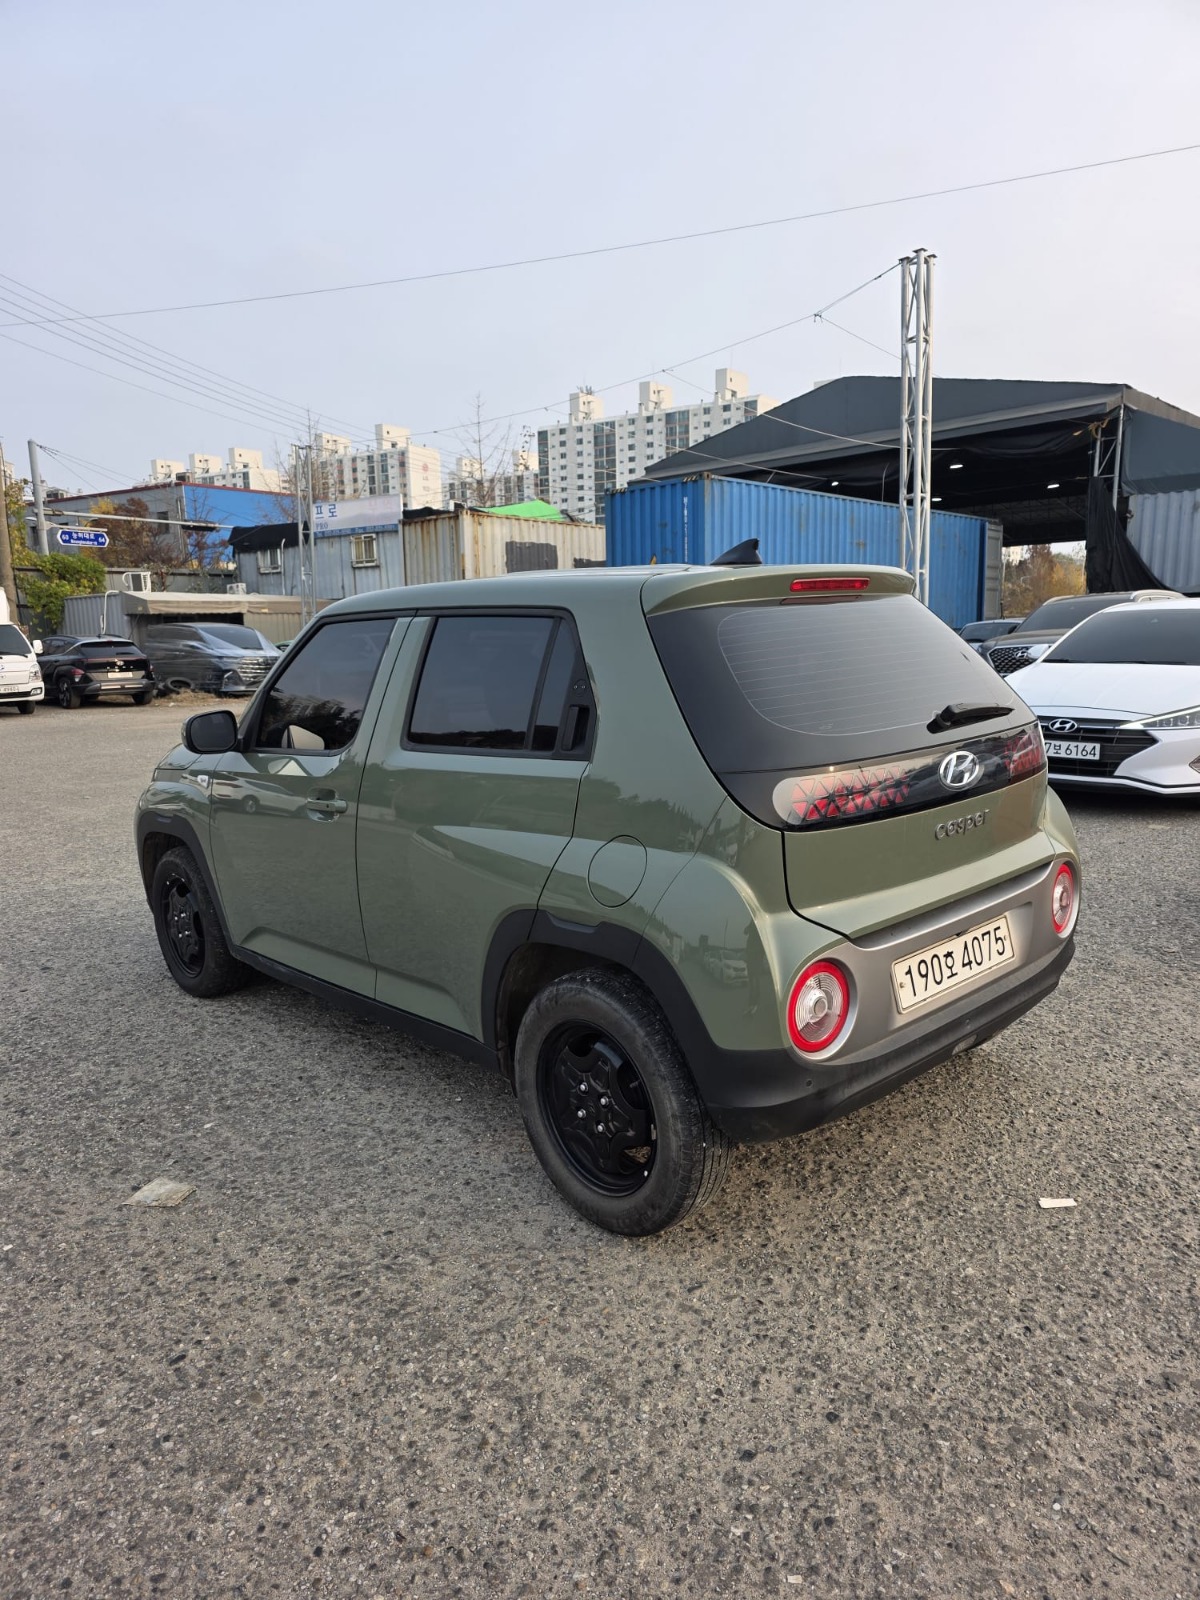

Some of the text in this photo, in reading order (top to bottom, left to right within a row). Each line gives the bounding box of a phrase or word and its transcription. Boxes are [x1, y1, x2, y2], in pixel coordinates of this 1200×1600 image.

[315, 503, 338, 520] 프로
[1065, 743, 1097, 758] 6164
[905, 926, 1006, 997] 190호 4075
